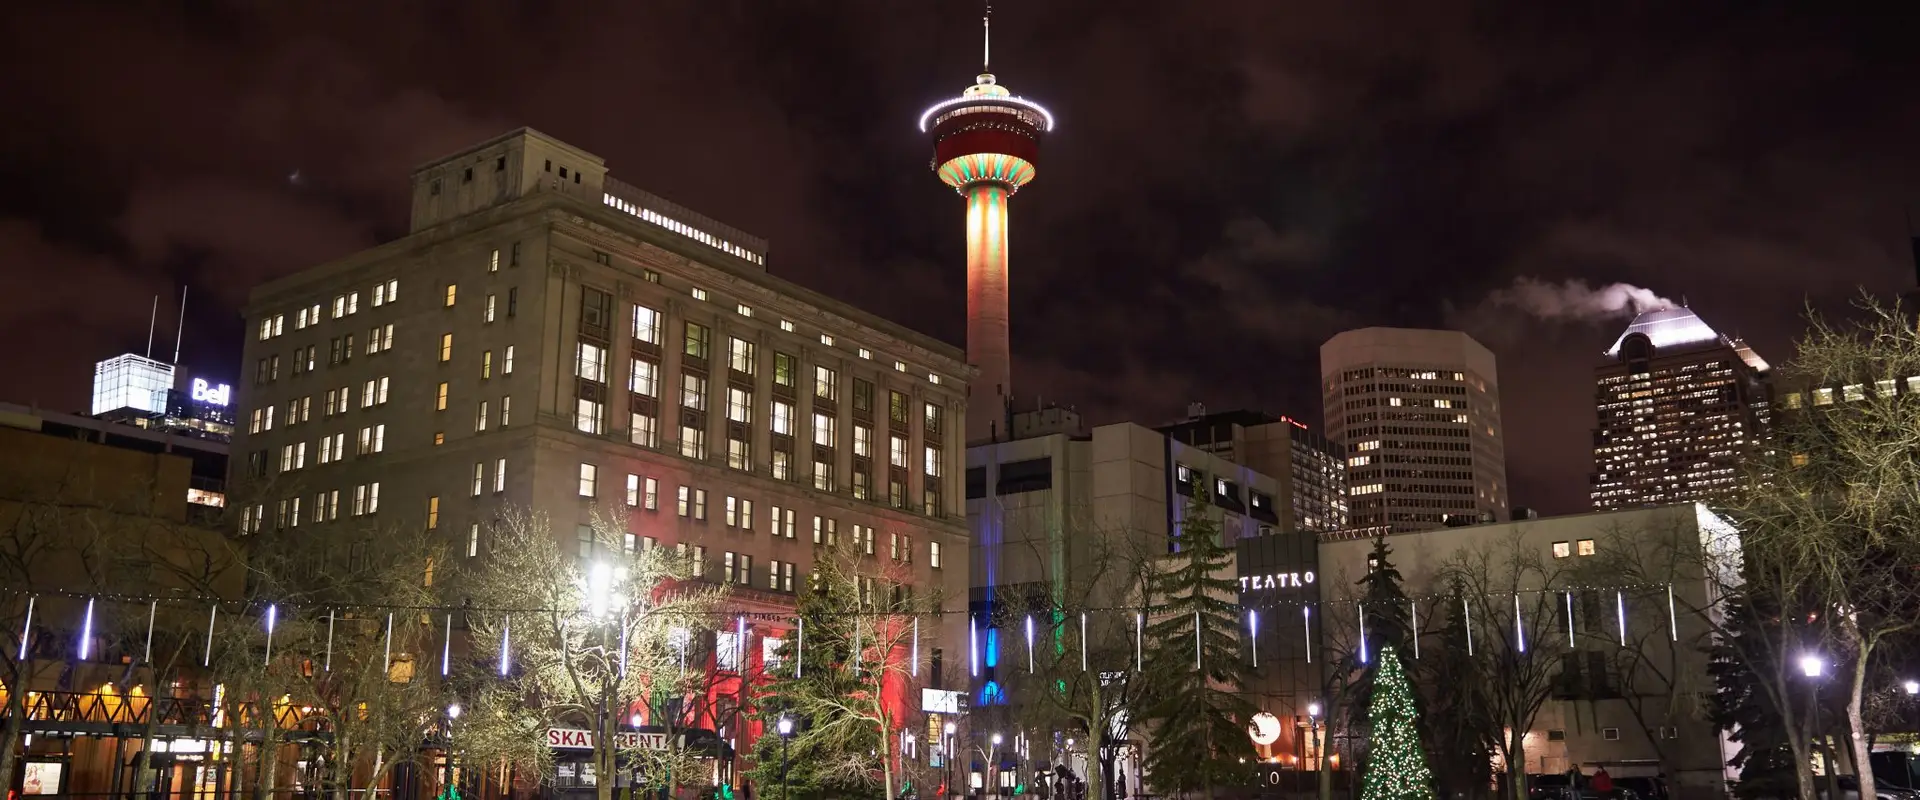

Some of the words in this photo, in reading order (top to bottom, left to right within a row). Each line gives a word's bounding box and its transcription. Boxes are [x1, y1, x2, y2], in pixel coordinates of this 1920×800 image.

[192, 377, 231, 407] Bell
[1239, 571, 1315, 593] TEATRO
[754, 612, 781, 622] SINGER
[548, 730, 598, 747] SKAT
